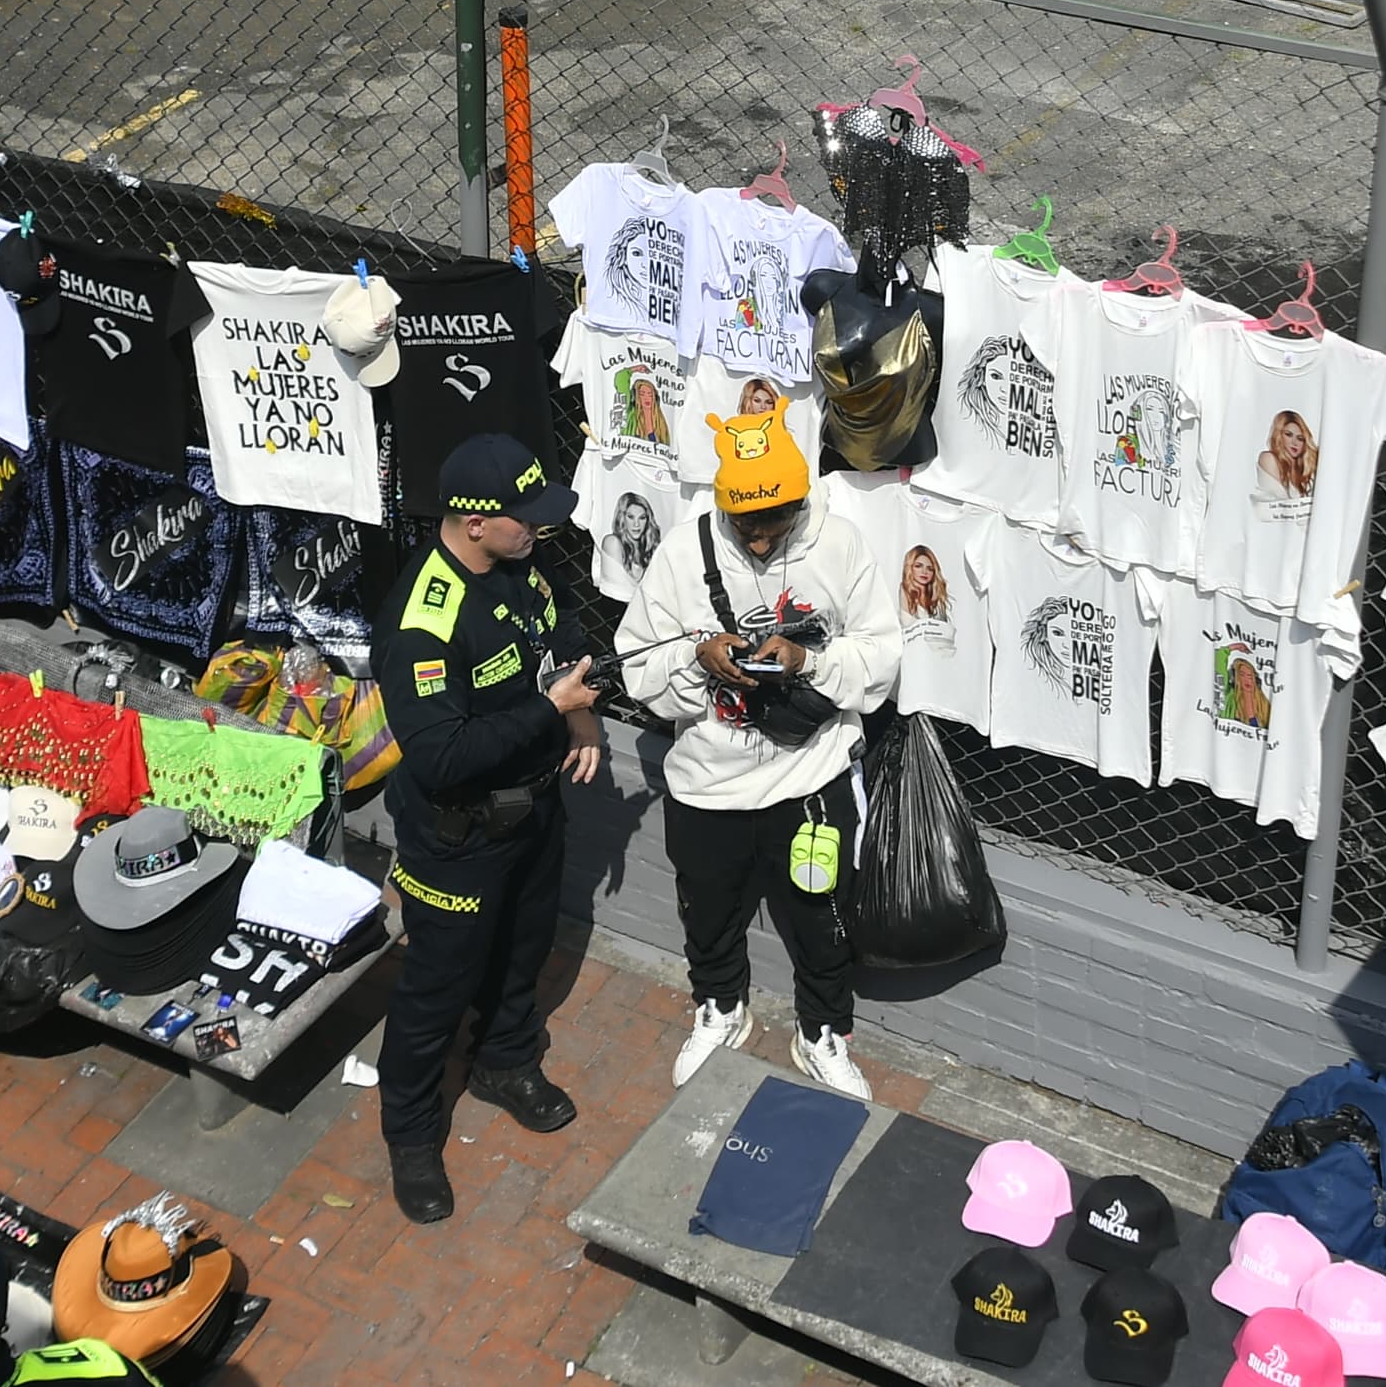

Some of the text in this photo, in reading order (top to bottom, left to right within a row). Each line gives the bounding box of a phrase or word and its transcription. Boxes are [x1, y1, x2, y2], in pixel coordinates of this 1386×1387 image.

[646, 217, 667, 241] YO
[649, 259, 679, 292] MAL
[59, 269, 153, 316] SHAKIRA
[222, 317, 333, 347] SHAKIRA
[397, 312, 513, 337] SHAKIRA
[256, 346, 307, 372] LAS
[600, 346, 685, 377] Las Mujeres
[716, 328, 811, 375] FACTURAN
[1008, 337, 1034, 363] YO
[231, 369, 340, 402] MUJERES
[1010, 361, 1055, 384] DERECH
[1008, 383, 1041, 421] MAL
[1103, 373, 1125, 405] LAS
[245, 397, 334, 428] YA NO
[1042, 397, 1057, 459] SOLTERA
[238, 423, 346, 456] LLORAN
[611, 437, 652, 454] Mujeres
[1007, 420, 1043, 458] BIEN
[729, 483, 780, 505] Pikachu
[110, 493, 203, 592] Shakira
[294, 520, 362, 608] Shaki
[1069, 597, 1095, 622] YO
[1072, 639, 1101, 671] MA
[1072, 673, 1100, 703] BIE
[1100, 655, 1113, 716] SOLTERA
[1088, 1210, 1140, 1244] SHAKIRA
[1240, 1253, 1290, 1287] SHAKIRA
[974, 1296, 1027, 1324] SHAKIRA
[1328, 1317, 1382, 1335] SHAKIRA
[1247, 1352, 1302, 1387] SHAKIRA
